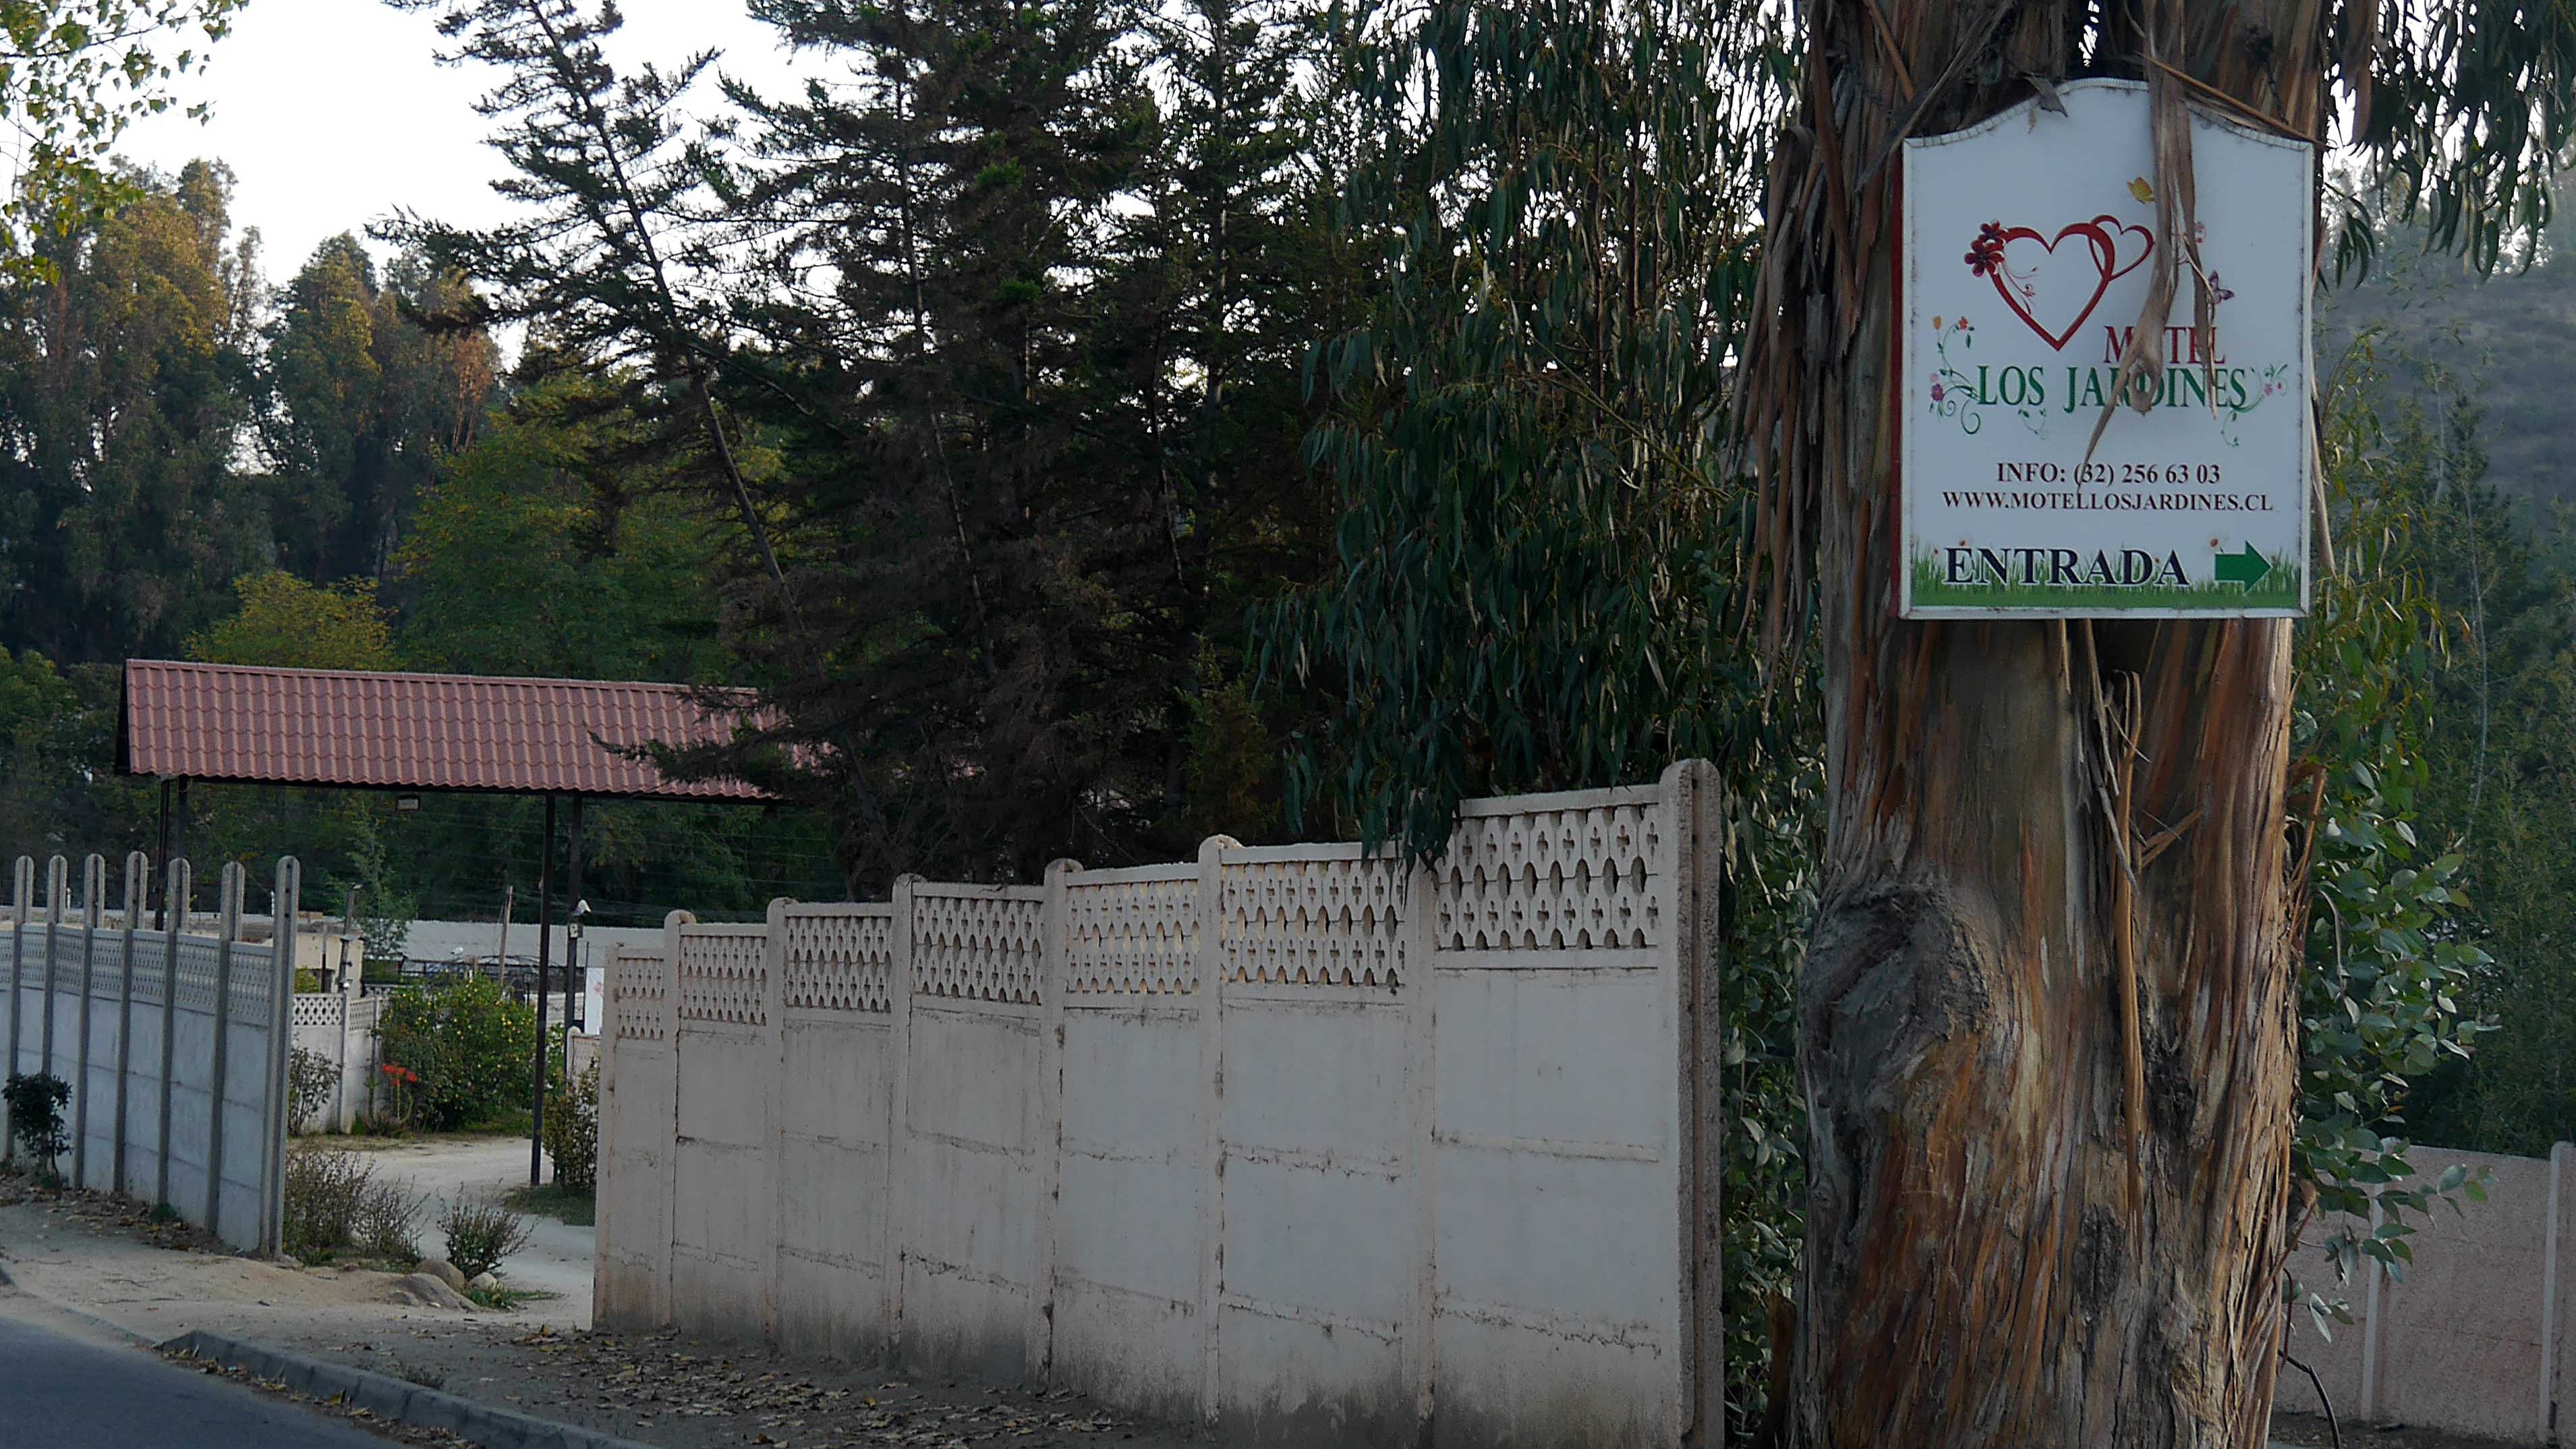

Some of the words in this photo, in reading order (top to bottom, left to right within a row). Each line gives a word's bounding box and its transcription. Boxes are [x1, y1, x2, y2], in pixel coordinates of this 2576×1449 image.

[1976, 365, 2044, 406] LOS
[1997, 462, 2065, 483] INFO:
[2121, 463, 2158, 484] 256
[2165, 463, 2189, 484] 63
[2196, 463, 2221, 484] 03
[1942, 492, 2273, 511] WWW.MOTELLOSJARDINES.CL
[1943, 547, 2190, 586] ENTRADA
